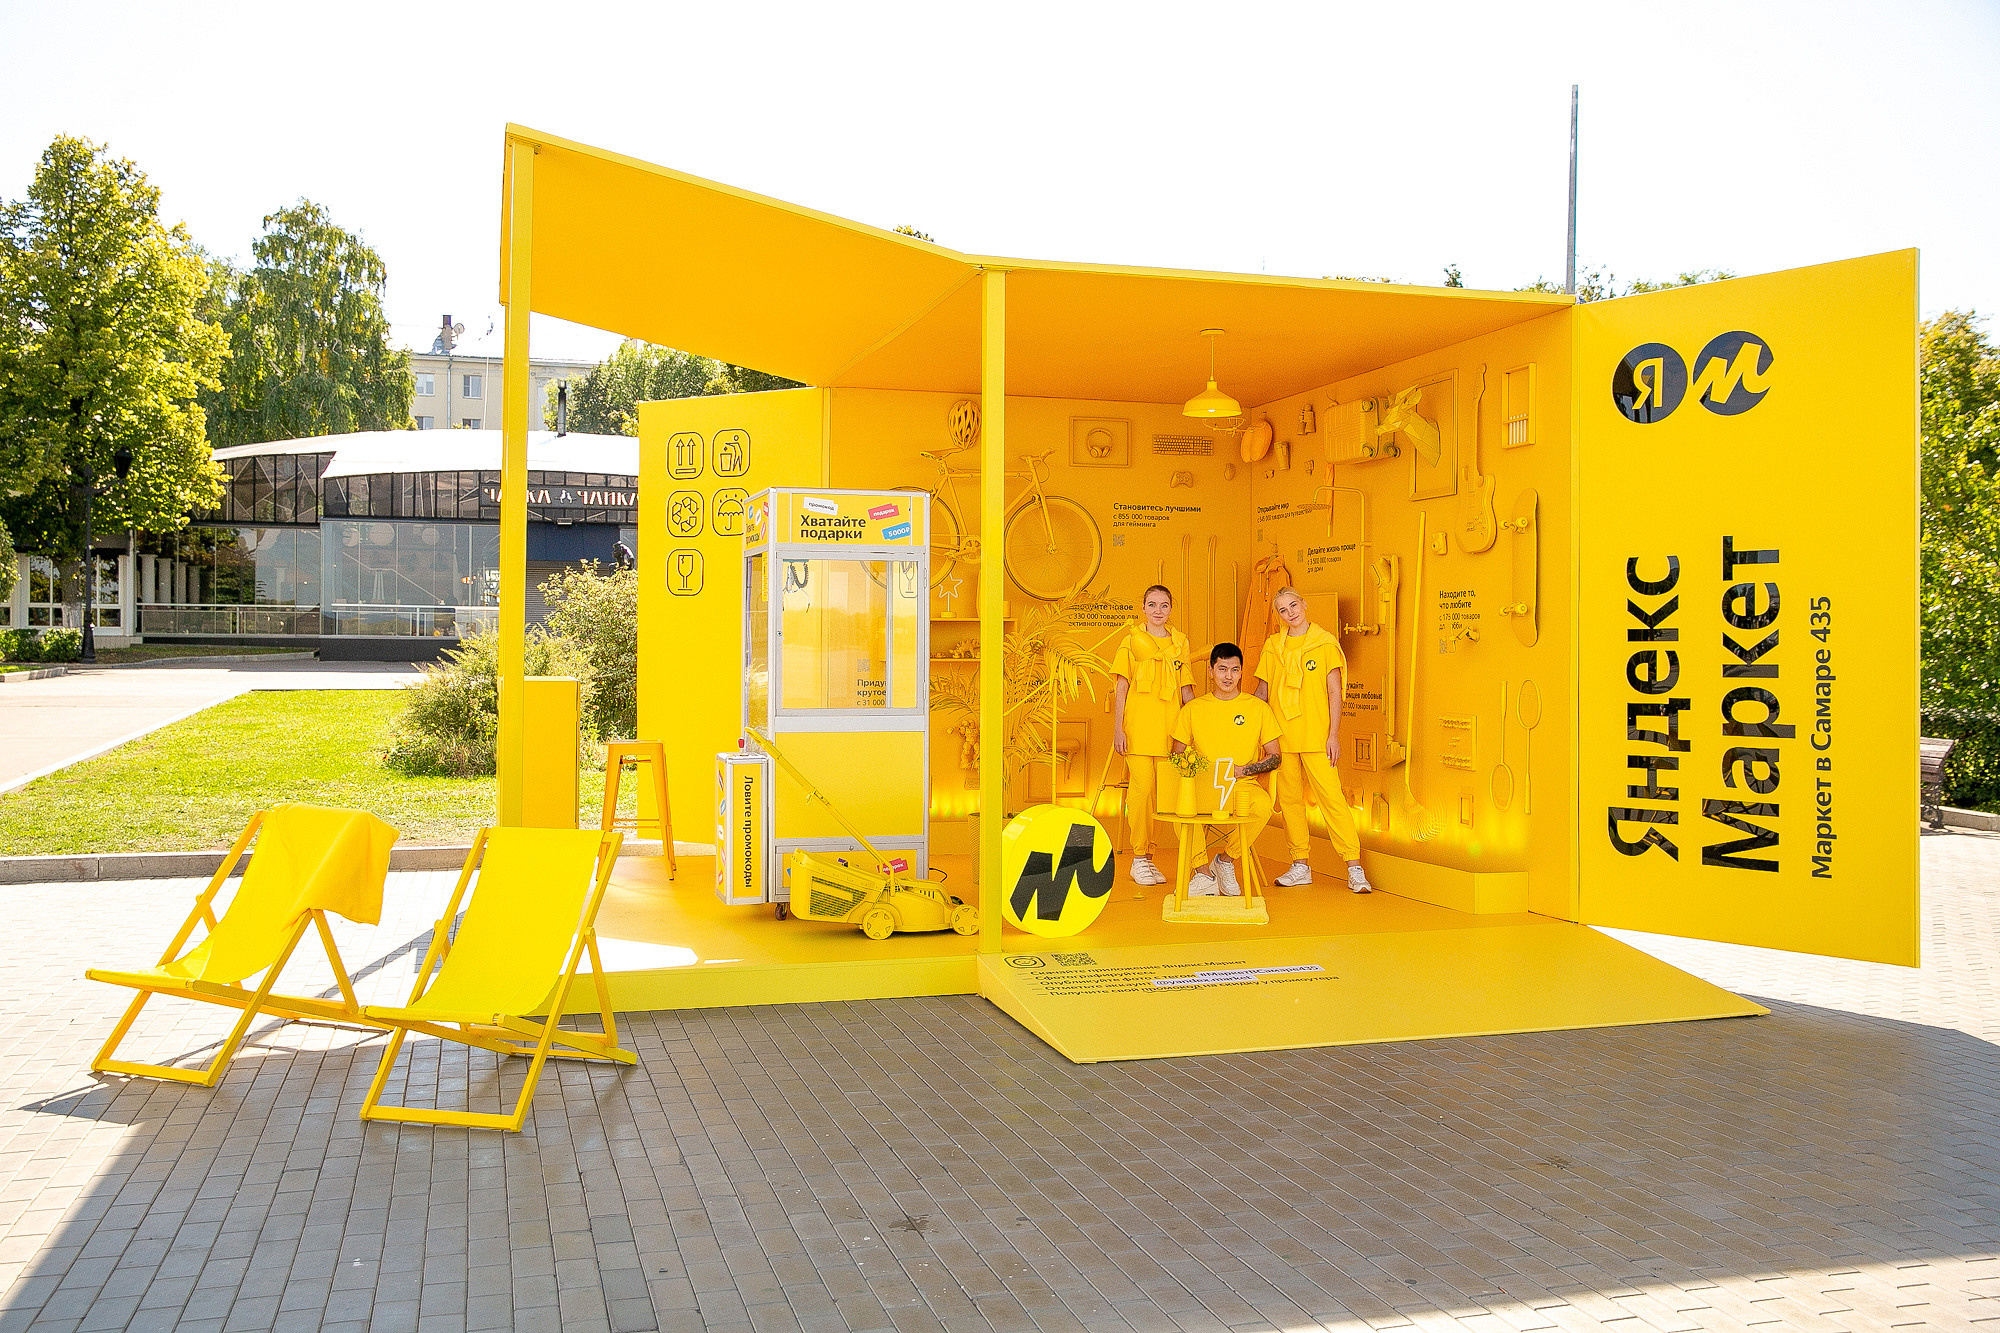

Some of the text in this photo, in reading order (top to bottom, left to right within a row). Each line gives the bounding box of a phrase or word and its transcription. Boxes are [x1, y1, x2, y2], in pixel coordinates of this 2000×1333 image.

[1113, 502, 1201, 513] Становитесь лучшими
[800, 514, 867, 528] Хватайте
[800, 529, 863, 542] подарки
[1341, 543, 1356, 551] проще
[1439, 589, 1476, 599] Находите то,
[1450, 599, 1472, 609] любите
[1452, 612, 1460, 620] 000
[1461, 613, 1480, 621] товаров
[857, 689, 886, 698] крутое
[1607, 555, 1691, 862] Яндекс
[1702, 536, 1796, 873] Маркет
[1810, 596, 1838, 879] Маркет в Самаре 435
[742, 775, 754, 888] Ловите промокоды
[1087, 965, 1161, 973] приложение
[1040, 977, 1120, 987] Опубликуйте
[1050, 988, 1109, 996] Получите
[1219, 980, 1260, 988] скидку
[1270, 975, 1340, 984] промоутера
[1156, 975, 1253, 986] @yandex.market
